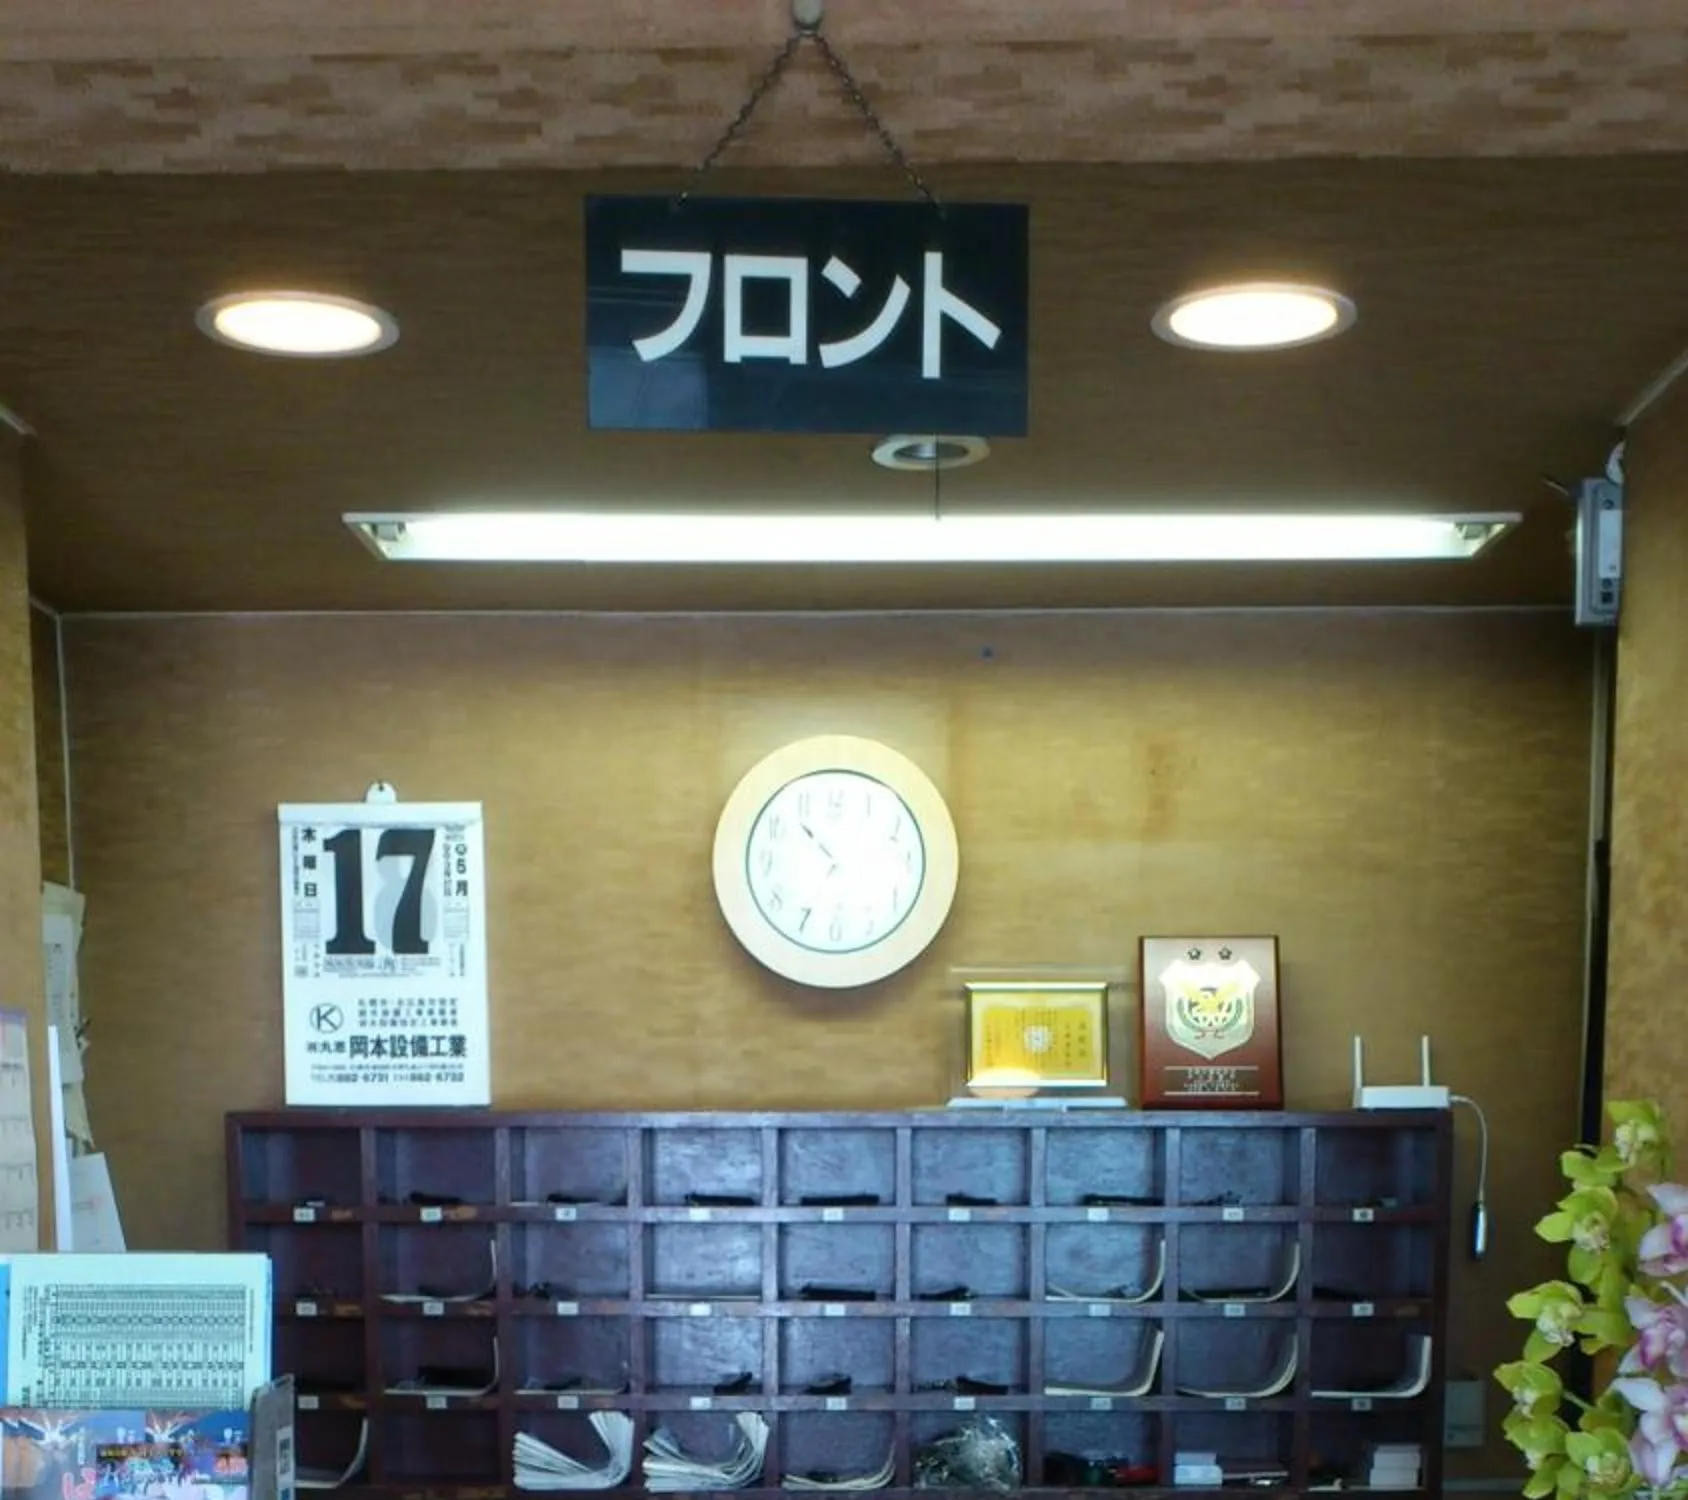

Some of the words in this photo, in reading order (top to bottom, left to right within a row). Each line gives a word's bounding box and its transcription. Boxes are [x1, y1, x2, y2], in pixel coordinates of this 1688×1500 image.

[621, 249, 1001, 378] フロント
[302, 827, 317, 897] 木曜日
[323, 828, 435, 954] 17
[350, 1034, 466, 1058] 岡本設備工業
